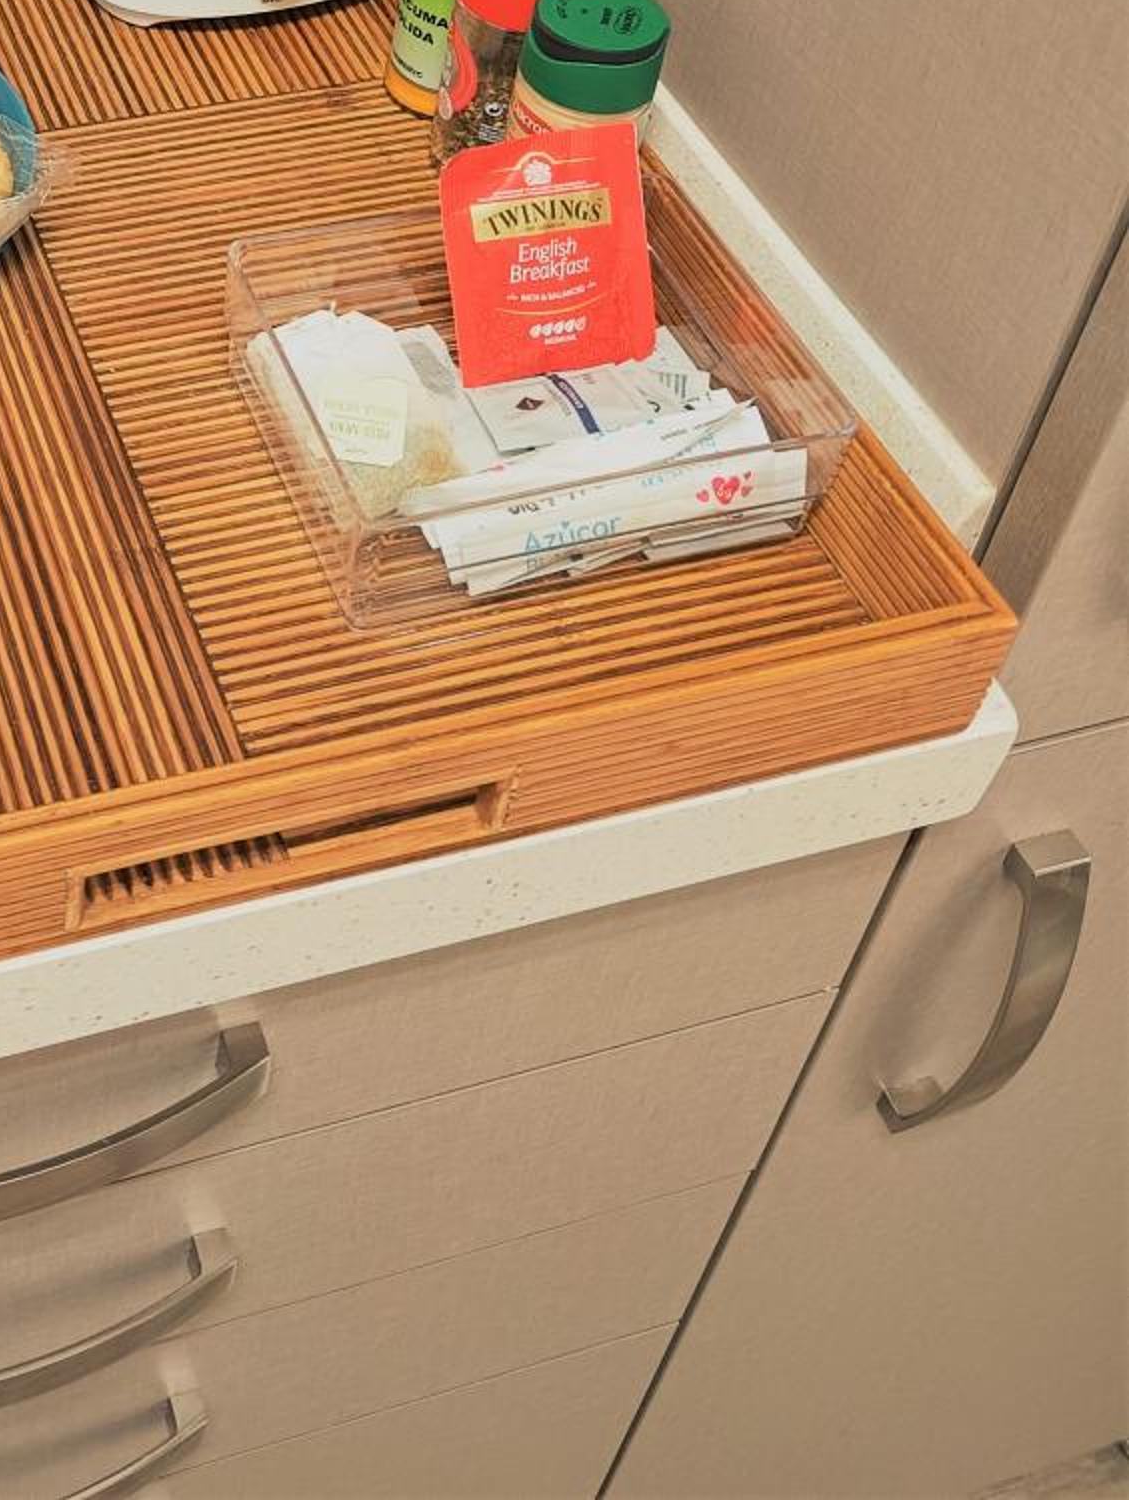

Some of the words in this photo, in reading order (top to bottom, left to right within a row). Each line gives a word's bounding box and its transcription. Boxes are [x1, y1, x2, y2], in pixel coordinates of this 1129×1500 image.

[483, 199, 602, 236] TWININGS
[518, 235, 578, 263] English
[509, 256, 591, 284] Breakfast
[525, 516, 622, 553] Azúcar
